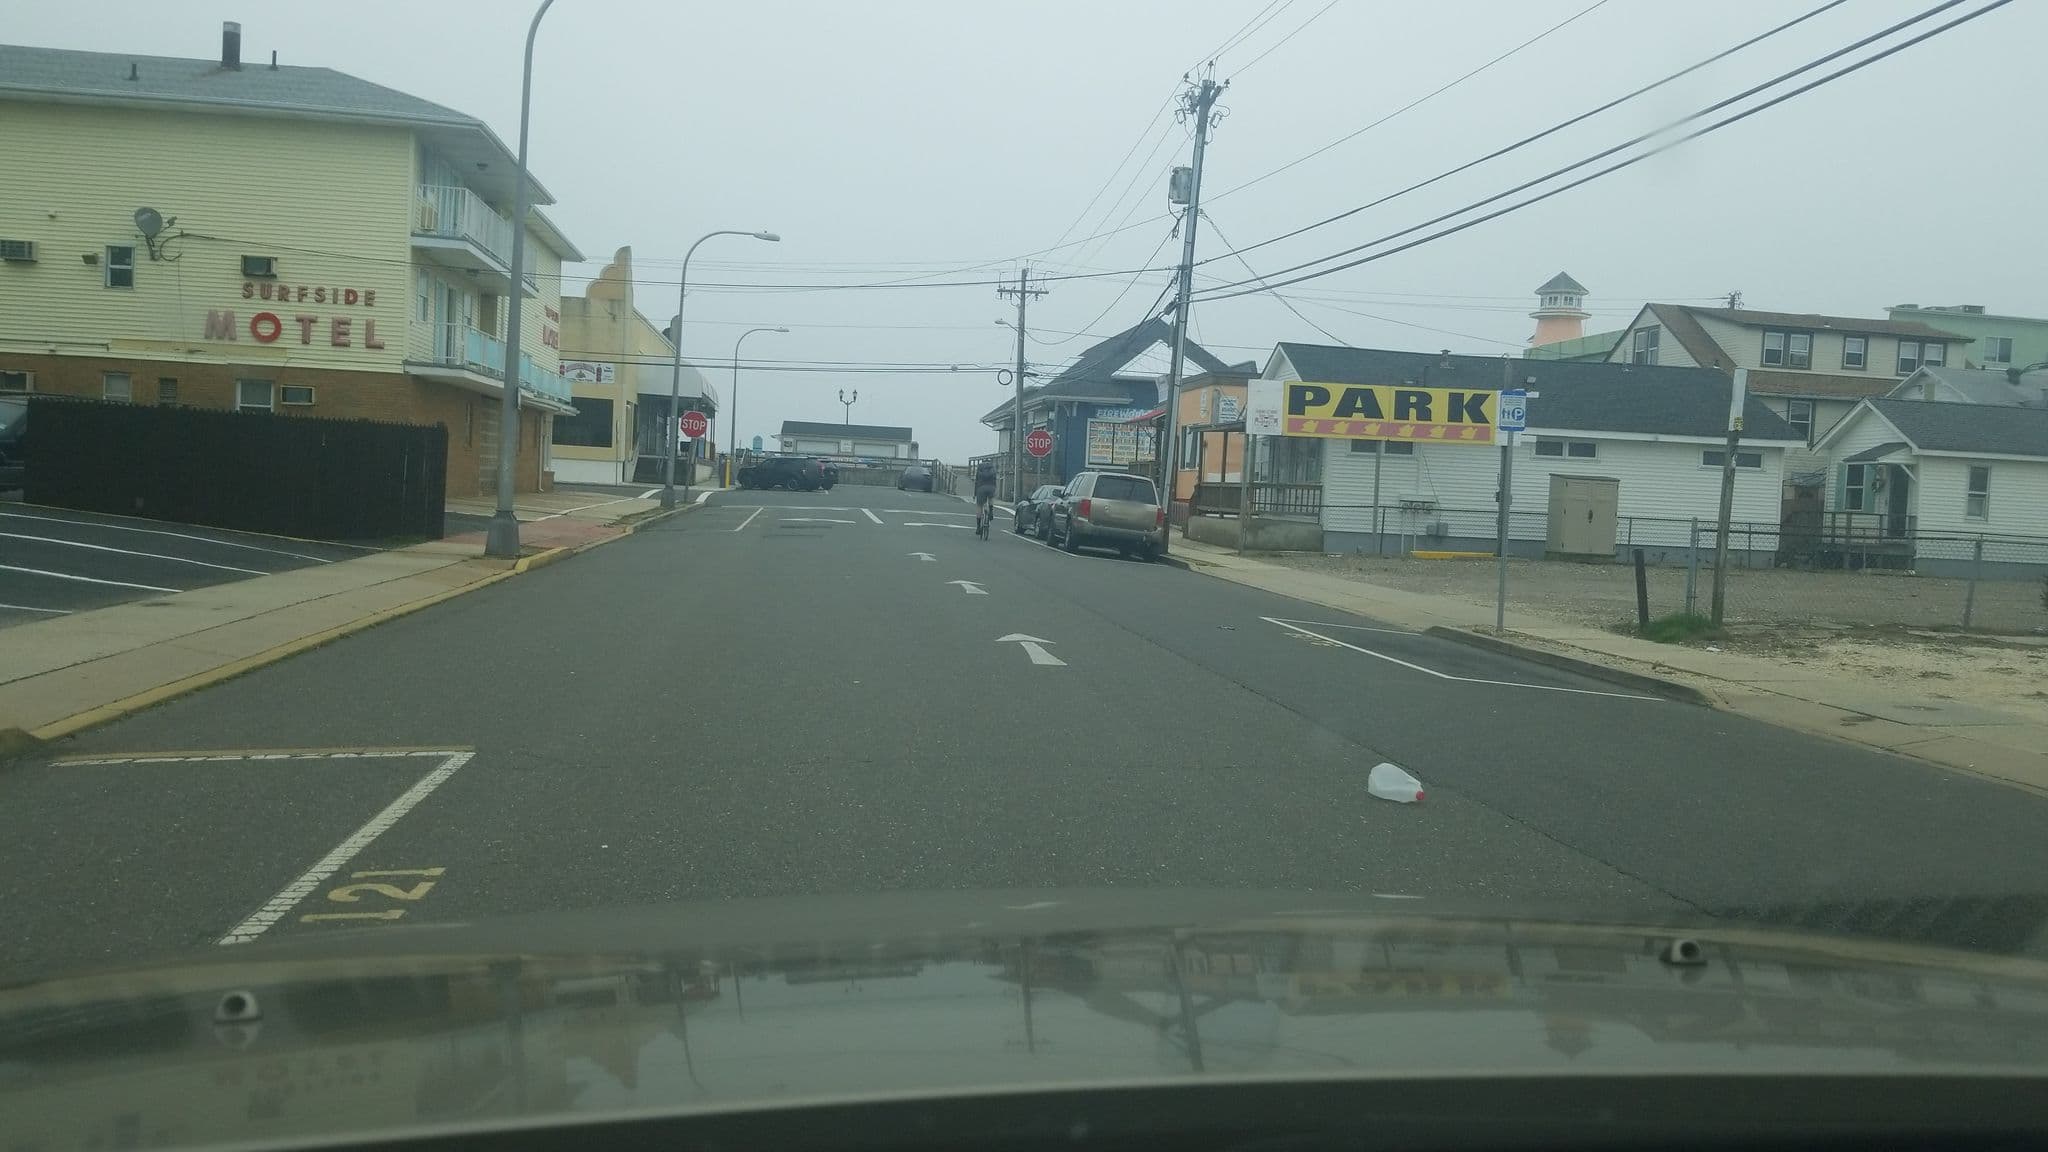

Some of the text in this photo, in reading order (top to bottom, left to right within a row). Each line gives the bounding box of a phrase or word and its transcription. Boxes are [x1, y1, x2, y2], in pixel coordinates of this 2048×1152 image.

[241, 281, 377, 308] SURFSIDE
[204, 308, 386, 350] MOTEL
[1287, 384, 1492, 425] PARK
[681, 418, 707, 431] STOP
[1027, 437, 1052, 449] STOP
[299, 866, 447, 923] 121
